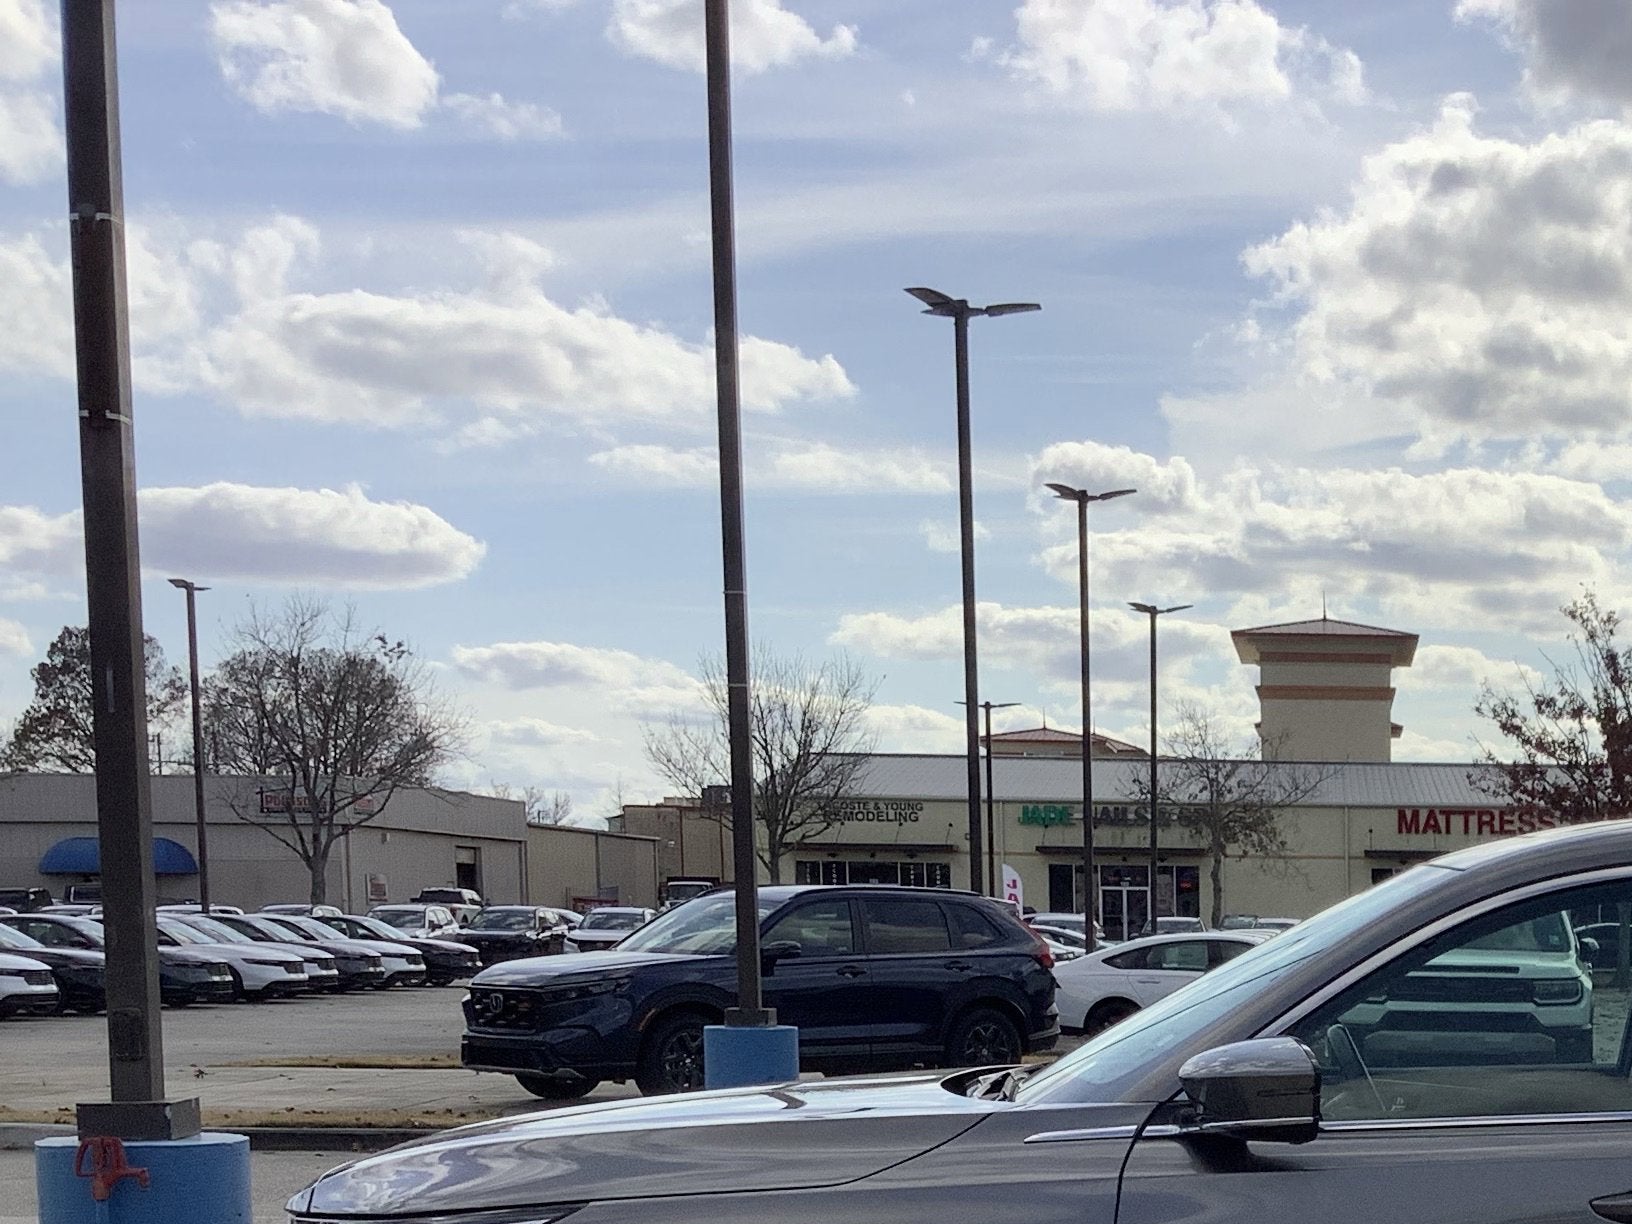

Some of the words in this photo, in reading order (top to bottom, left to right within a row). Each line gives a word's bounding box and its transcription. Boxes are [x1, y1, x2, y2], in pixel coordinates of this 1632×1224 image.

[873, 802, 880, 811] &
[884, 802, 924, 812] YOUNG
[824, 811, 919, 822] REMODELING
[1018, 805, 1077, 826] JADE
[1397, 808, 1556, 834] MATTRESS
